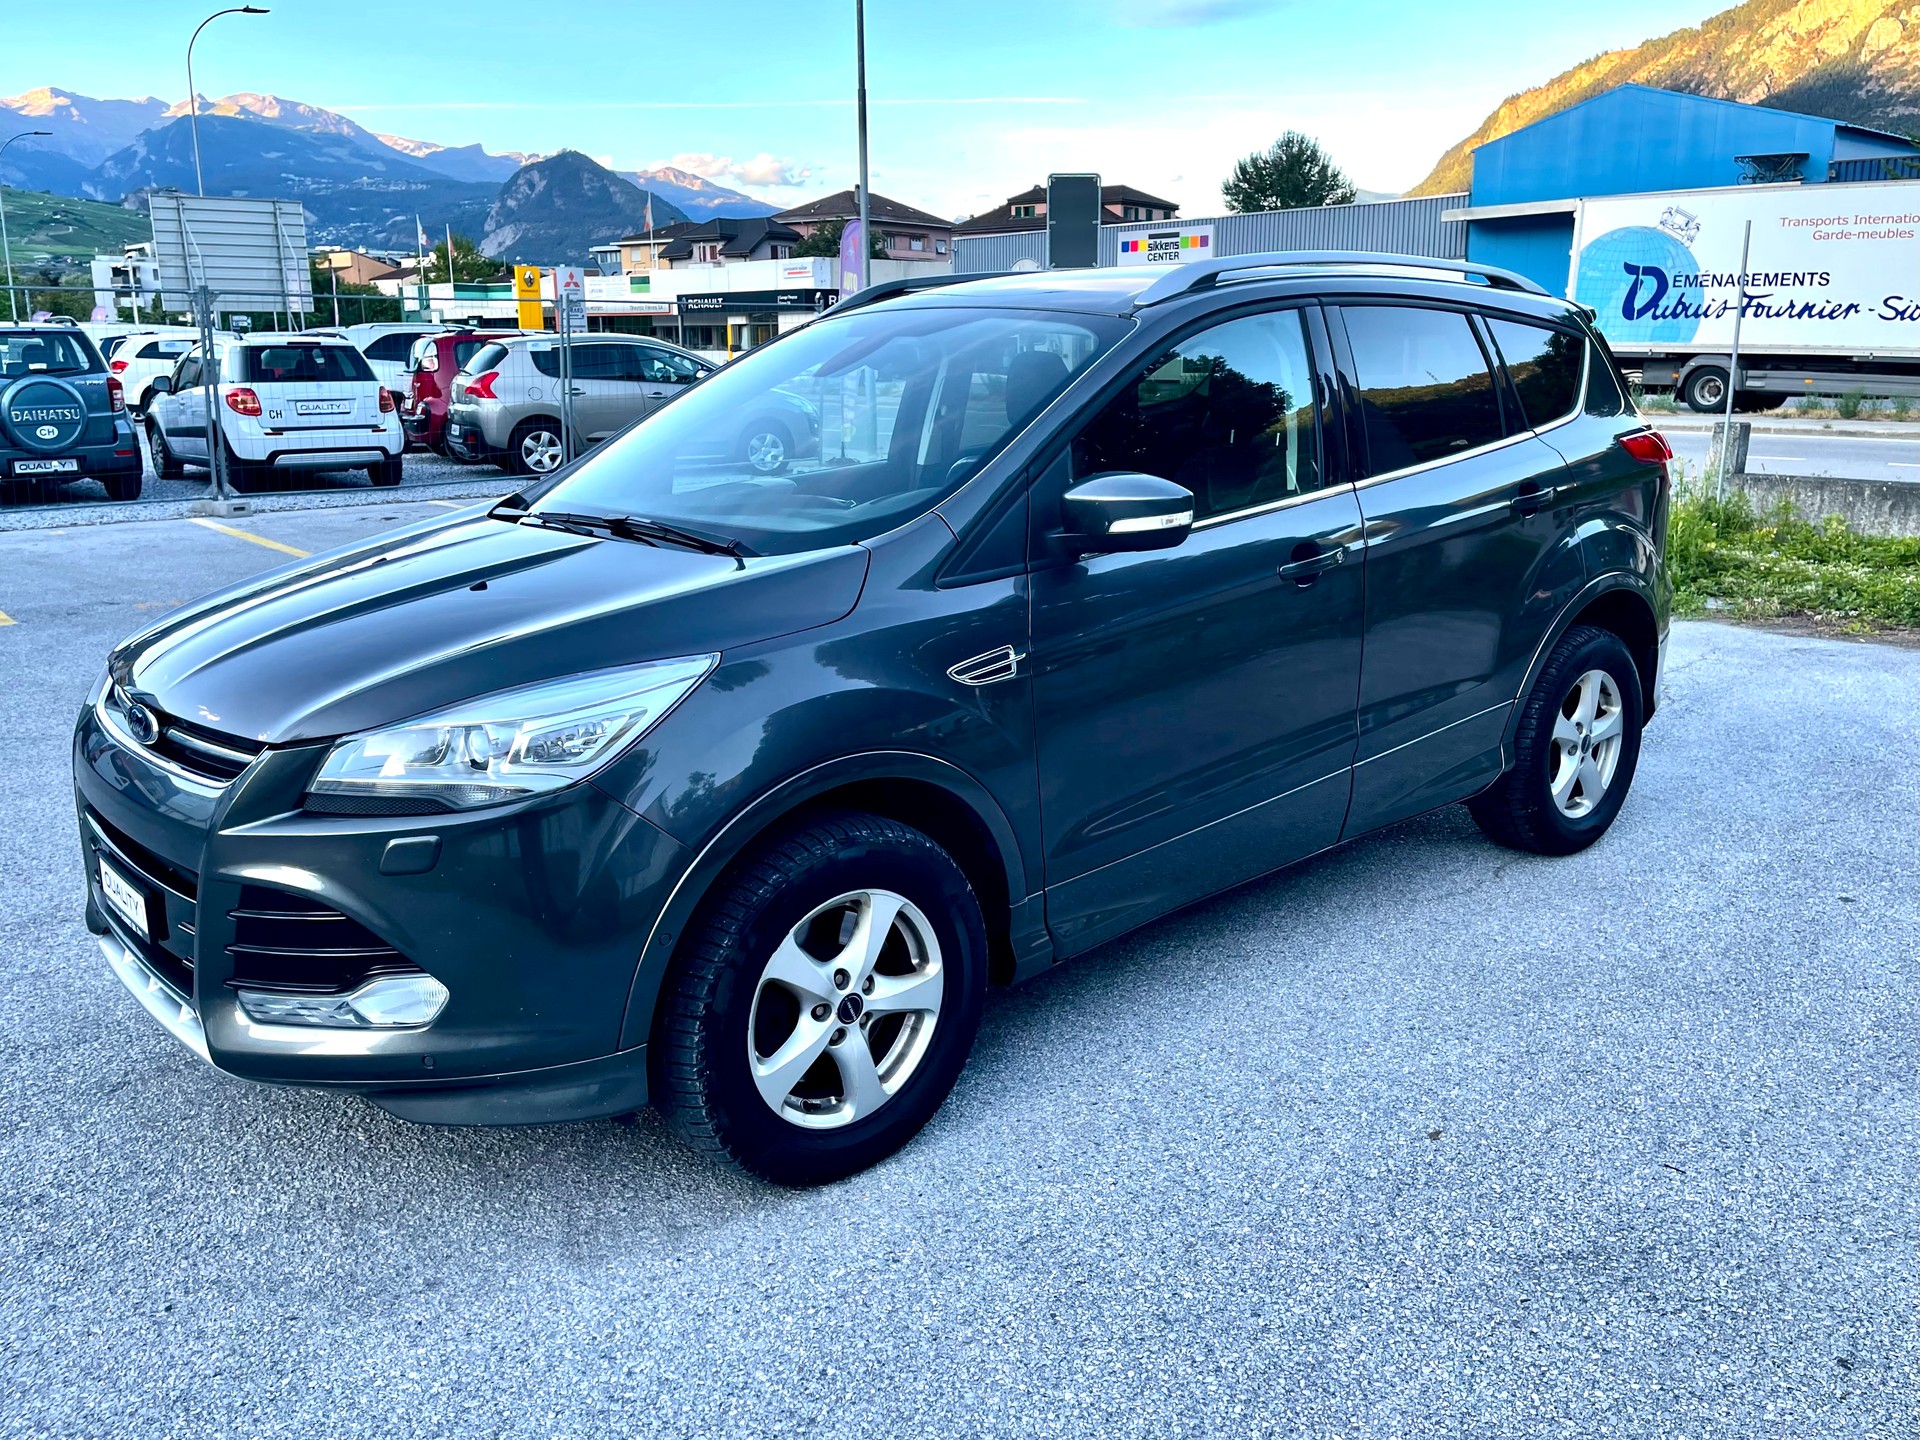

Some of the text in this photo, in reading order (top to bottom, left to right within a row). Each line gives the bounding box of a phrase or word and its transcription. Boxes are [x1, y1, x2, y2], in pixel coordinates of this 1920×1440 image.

[1780, 216, 1849, 228] Transports
[1812, 228, 1915, 241] Garde-meubles
[1148, 240, 1180, 252] sikkens
[1147, 251, 1180, 262] CENTER
[688, 297, 723, 309] RENAULT
[11, 408, 81, 422] DAIHATSU
[268, 409, 283, 420] CH
[39, 428, 55, 437] CH
